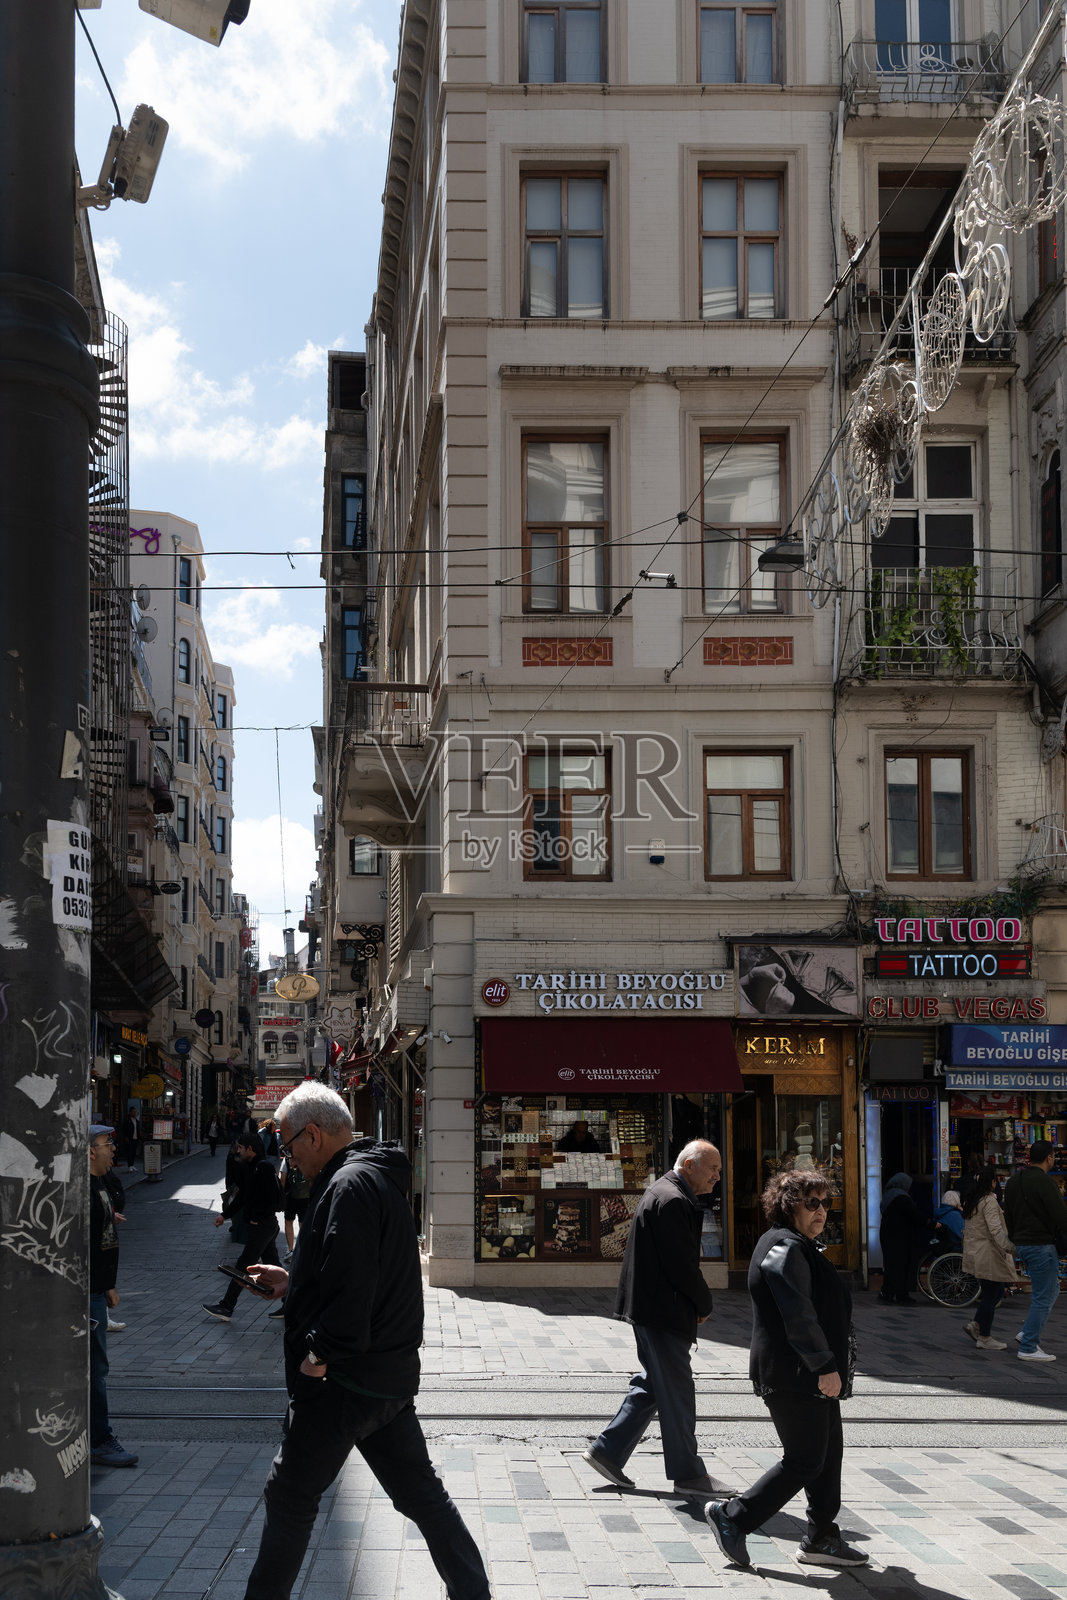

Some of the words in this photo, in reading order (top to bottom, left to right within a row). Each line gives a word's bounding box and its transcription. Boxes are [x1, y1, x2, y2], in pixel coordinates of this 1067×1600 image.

[874, 917, 1022, 943] TATTOO
[908, 953, 998, 977] TATTOO
[616, 970, 727, 991] BEYOĞLU
[485, 983, 507, 997] elit
[538, 989, 704, 1015] ÇİKOLATACISI
[868, 996, 940, 1019] CLUB
[953, 997, 1047, 1019] VEGAS
[1001, 1028, 1050, 1044] TARİHİ
[966, 1045, 1033, 1060] BEYOĞLU
[948, 1071, 990, 1086] TARİHİ
[993, 1072, 1049, 1087] BEYOĞLU
[1052, 1072, 1067, 1087] Gİ
[871, 1085, 930, 1101] TATTOO
